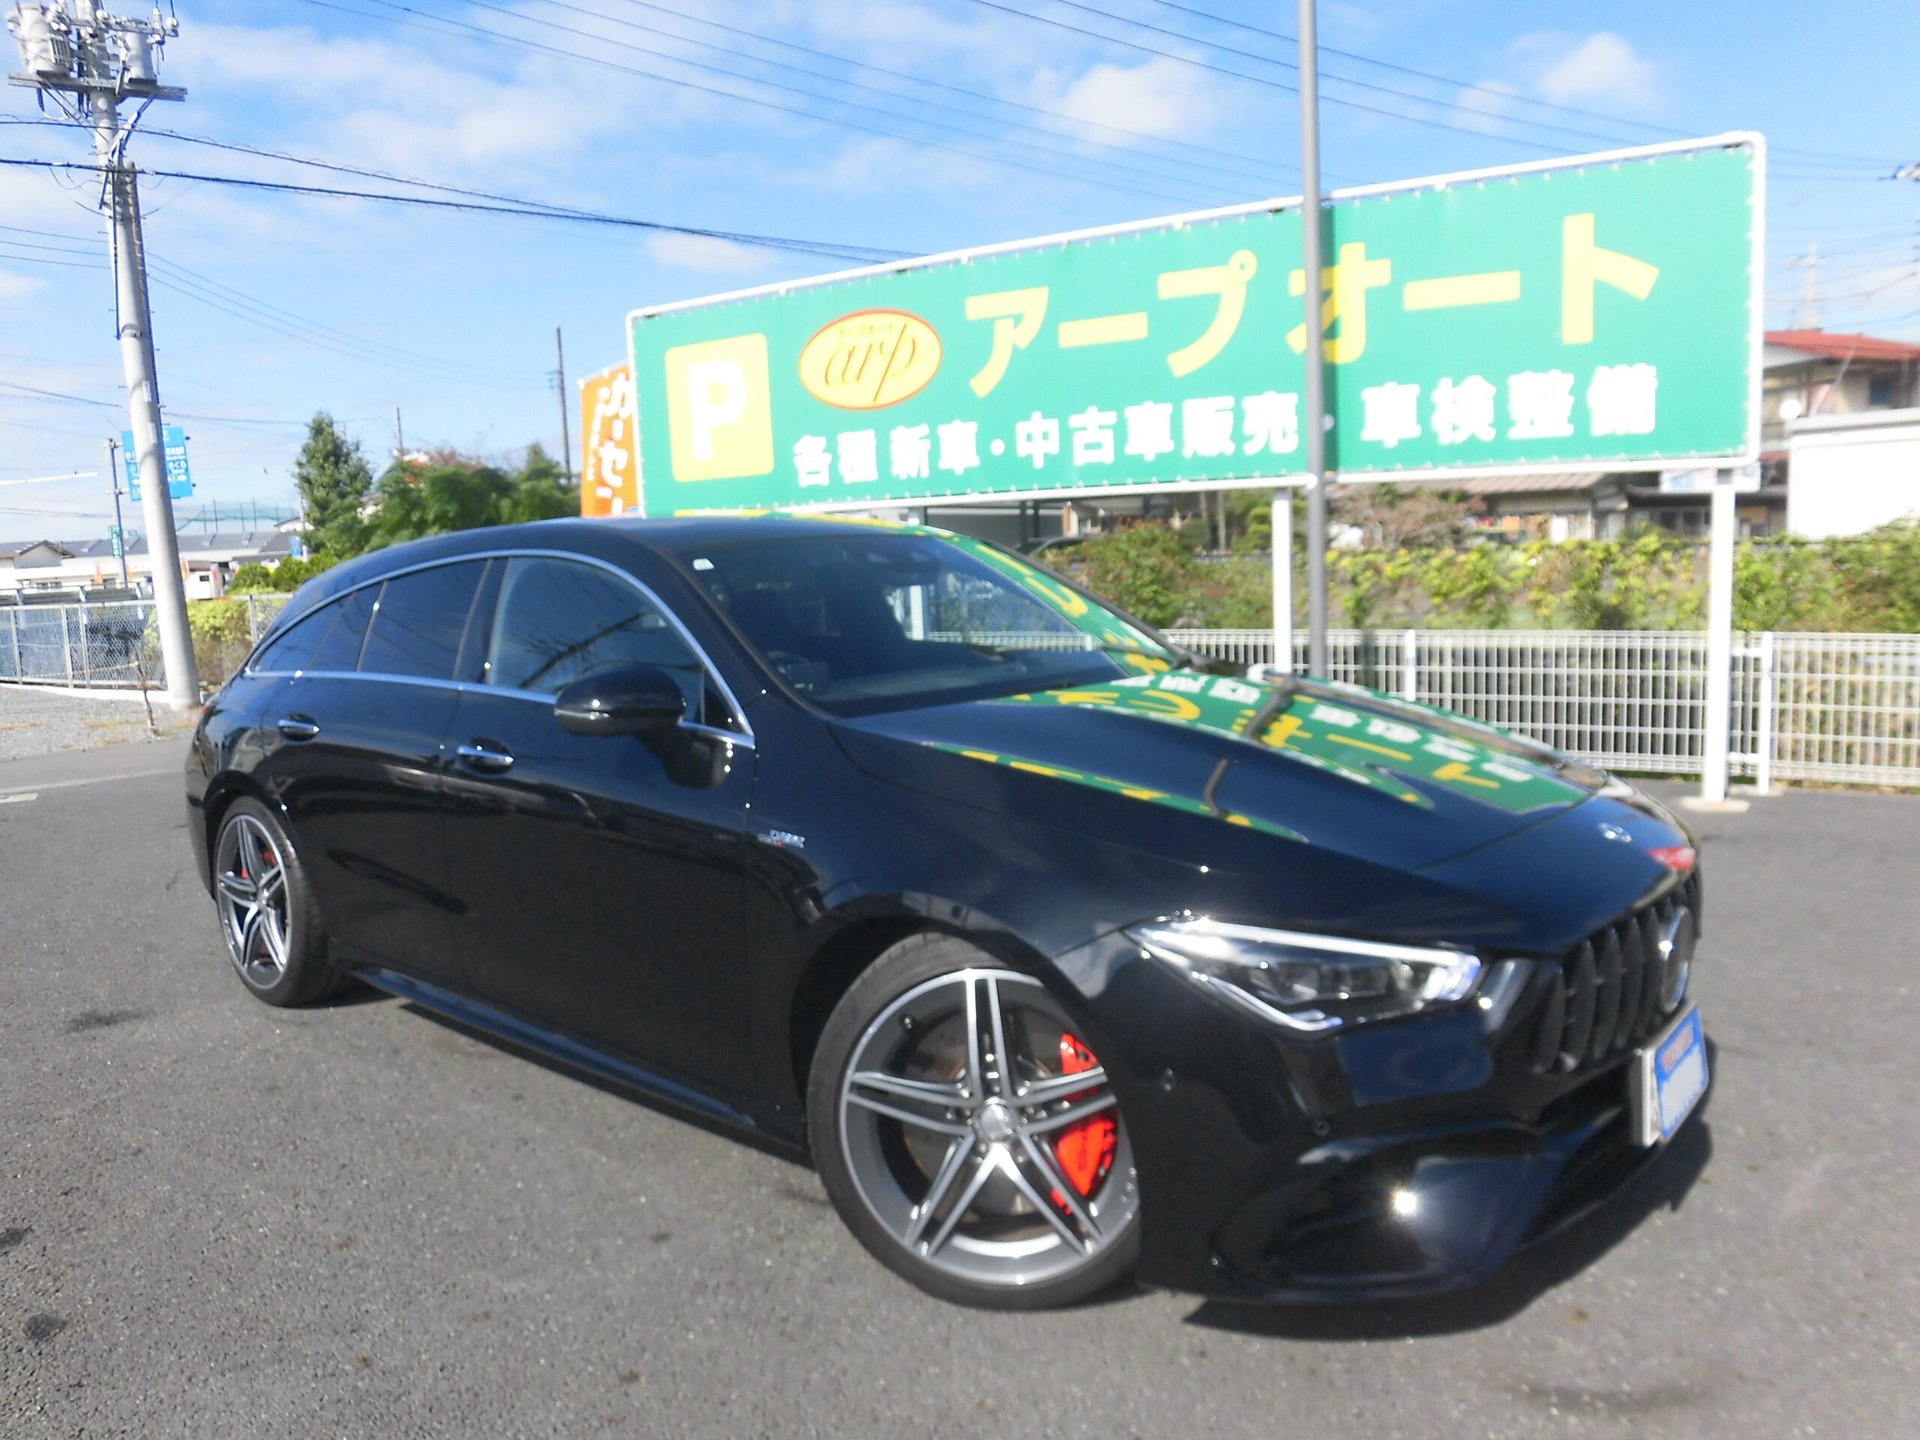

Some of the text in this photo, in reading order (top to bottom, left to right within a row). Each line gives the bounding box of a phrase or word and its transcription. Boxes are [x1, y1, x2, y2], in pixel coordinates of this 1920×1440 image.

[965, 213, 1660, 398] アープオート
[687, 359, 747, 462] P
